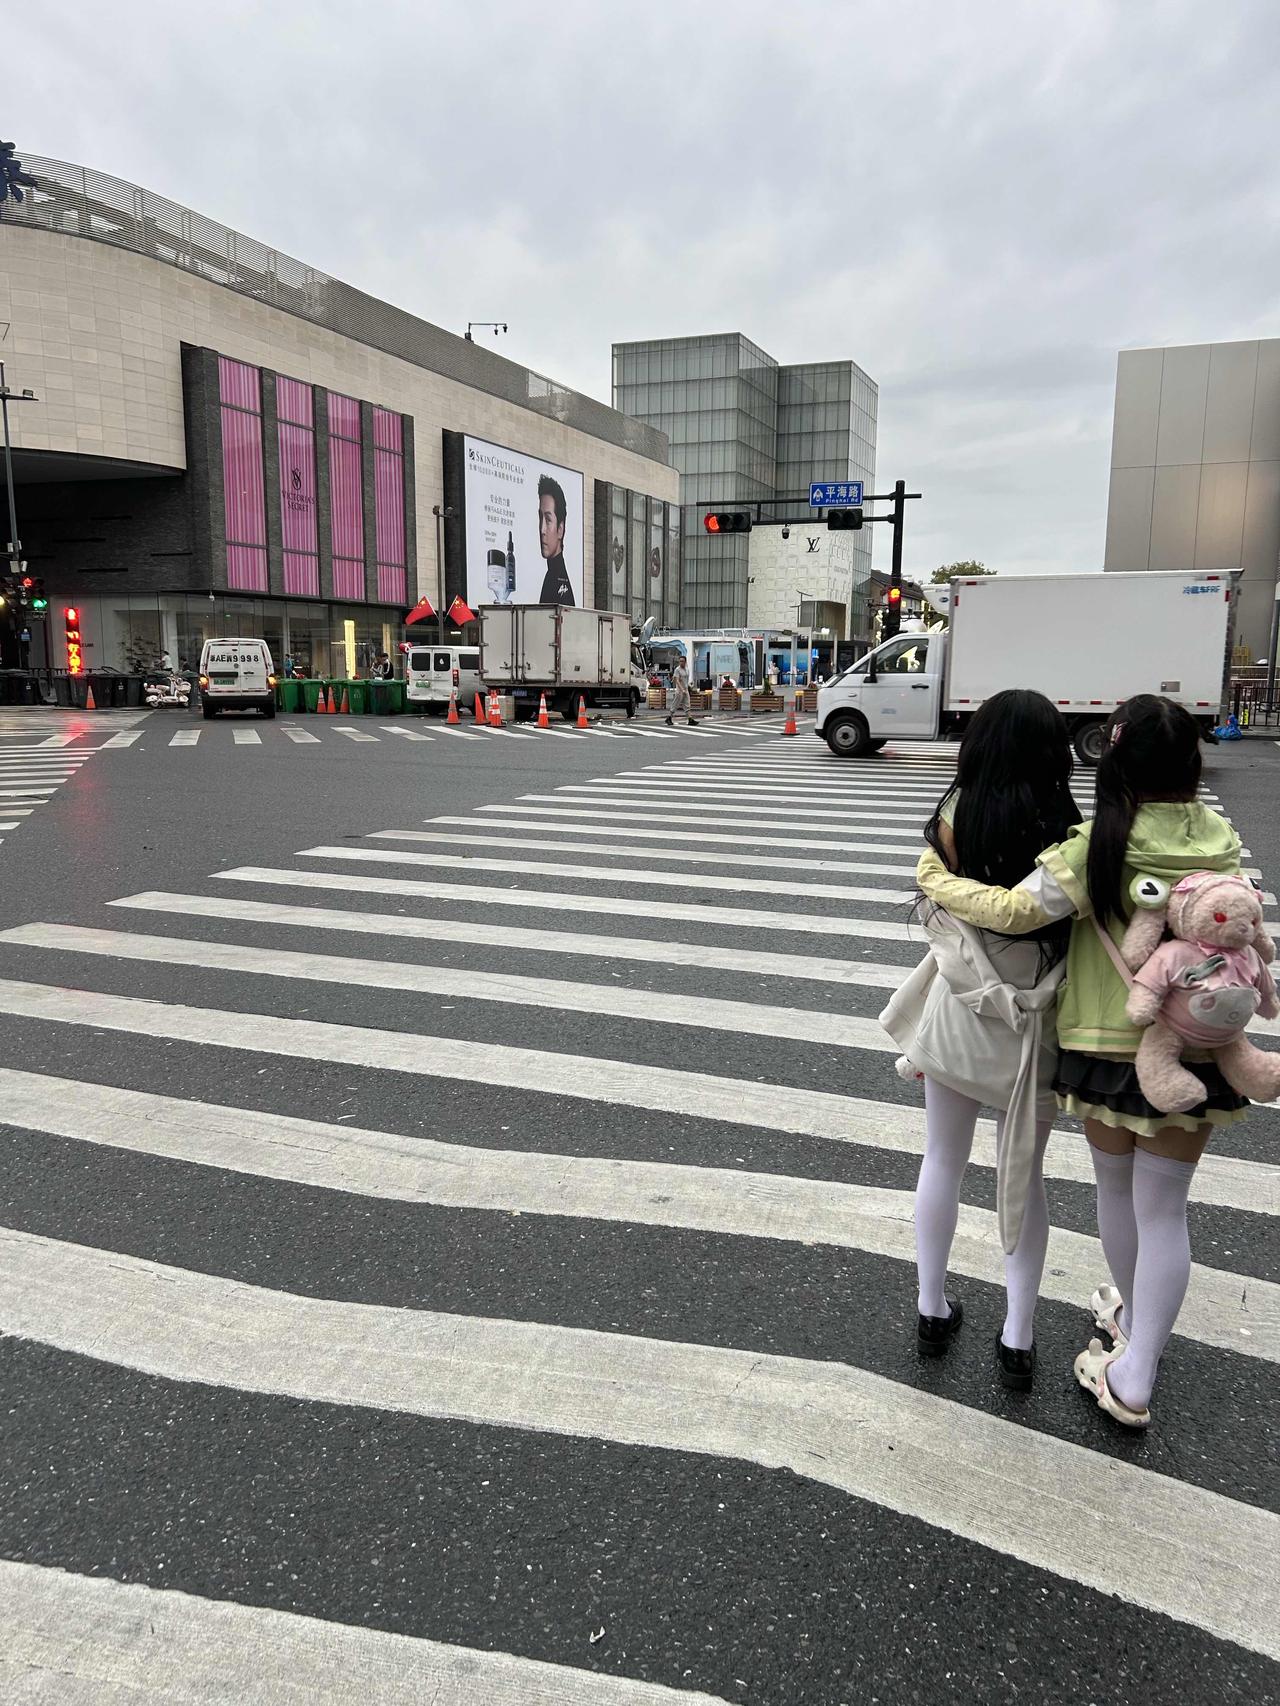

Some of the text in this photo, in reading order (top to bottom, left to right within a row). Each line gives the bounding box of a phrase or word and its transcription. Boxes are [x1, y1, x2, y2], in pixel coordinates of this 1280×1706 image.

[825, 485, 859, 498] 平海路
[287, 500, 309, 513] SECRET
